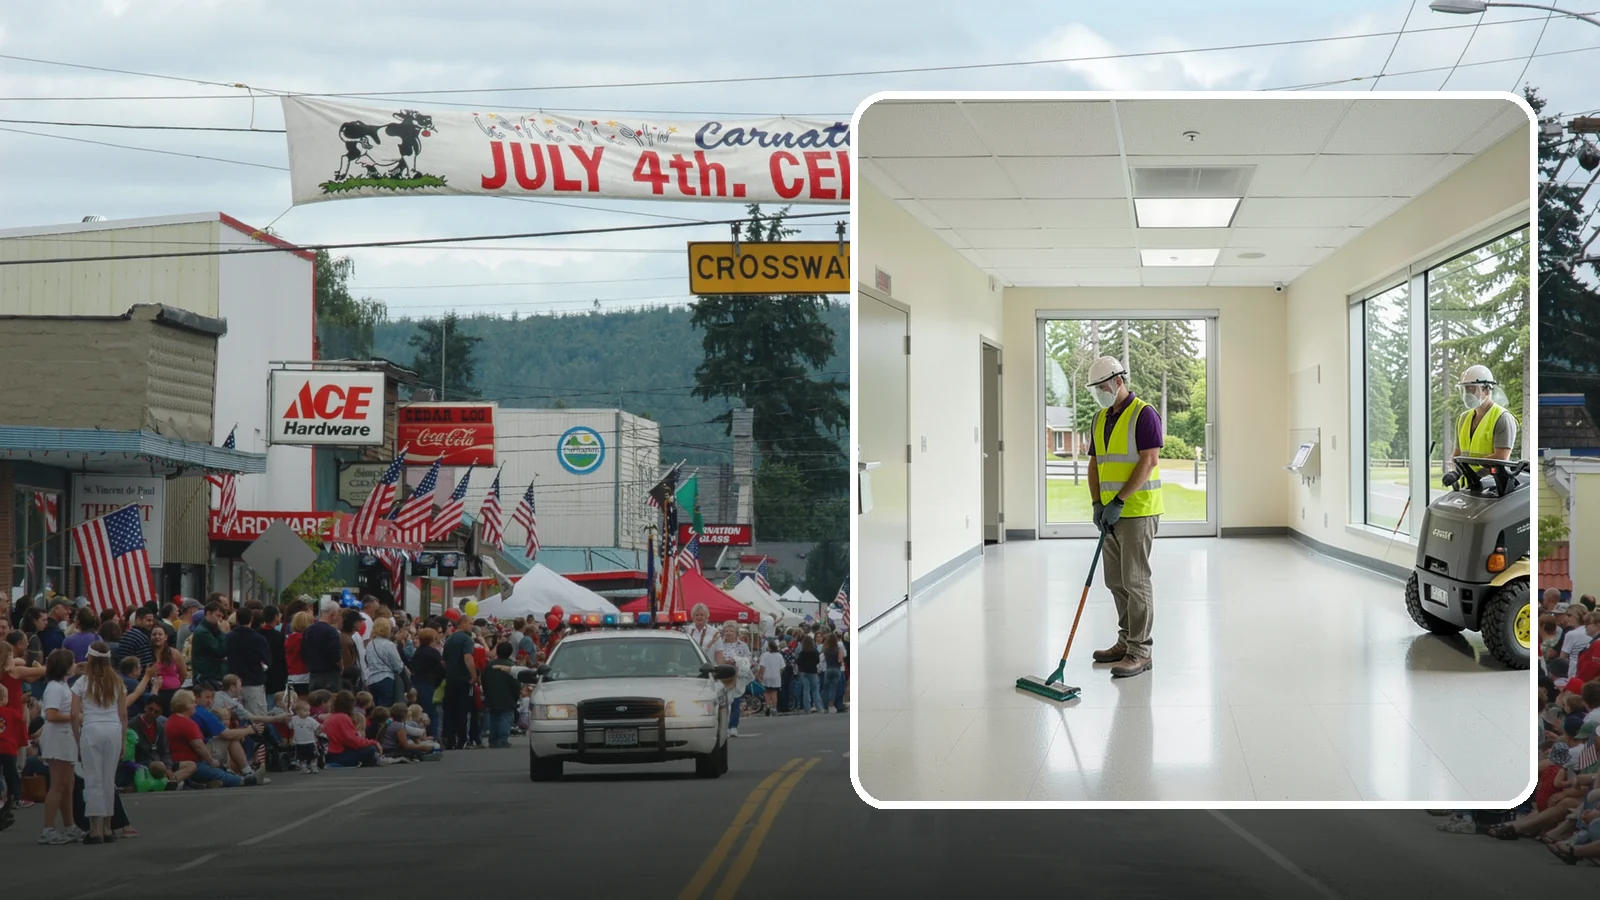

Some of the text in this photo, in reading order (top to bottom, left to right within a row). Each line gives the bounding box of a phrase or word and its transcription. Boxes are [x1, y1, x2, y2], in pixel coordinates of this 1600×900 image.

[694, 121, 850, 150] Carnat
[481, 141, 604, 192] JULY
[632, 150, 746, 197] 4th.
[697, 254, 850, 280] CROSSWA
[282, 379, 373, 419] ACE
[283, 421, 370, 436] Hardware
[416, 428, 477, 447] Coca-Cola
[95, 485, 124, 495] Vincent
[126, 485, 136, 495] de
[137, 486, 155, 495] Paul
[212, 516, 330, 535] HARDARE
[688, 526, 741, 535] CRNATION
[699, 535, 730, 543] GLASS
